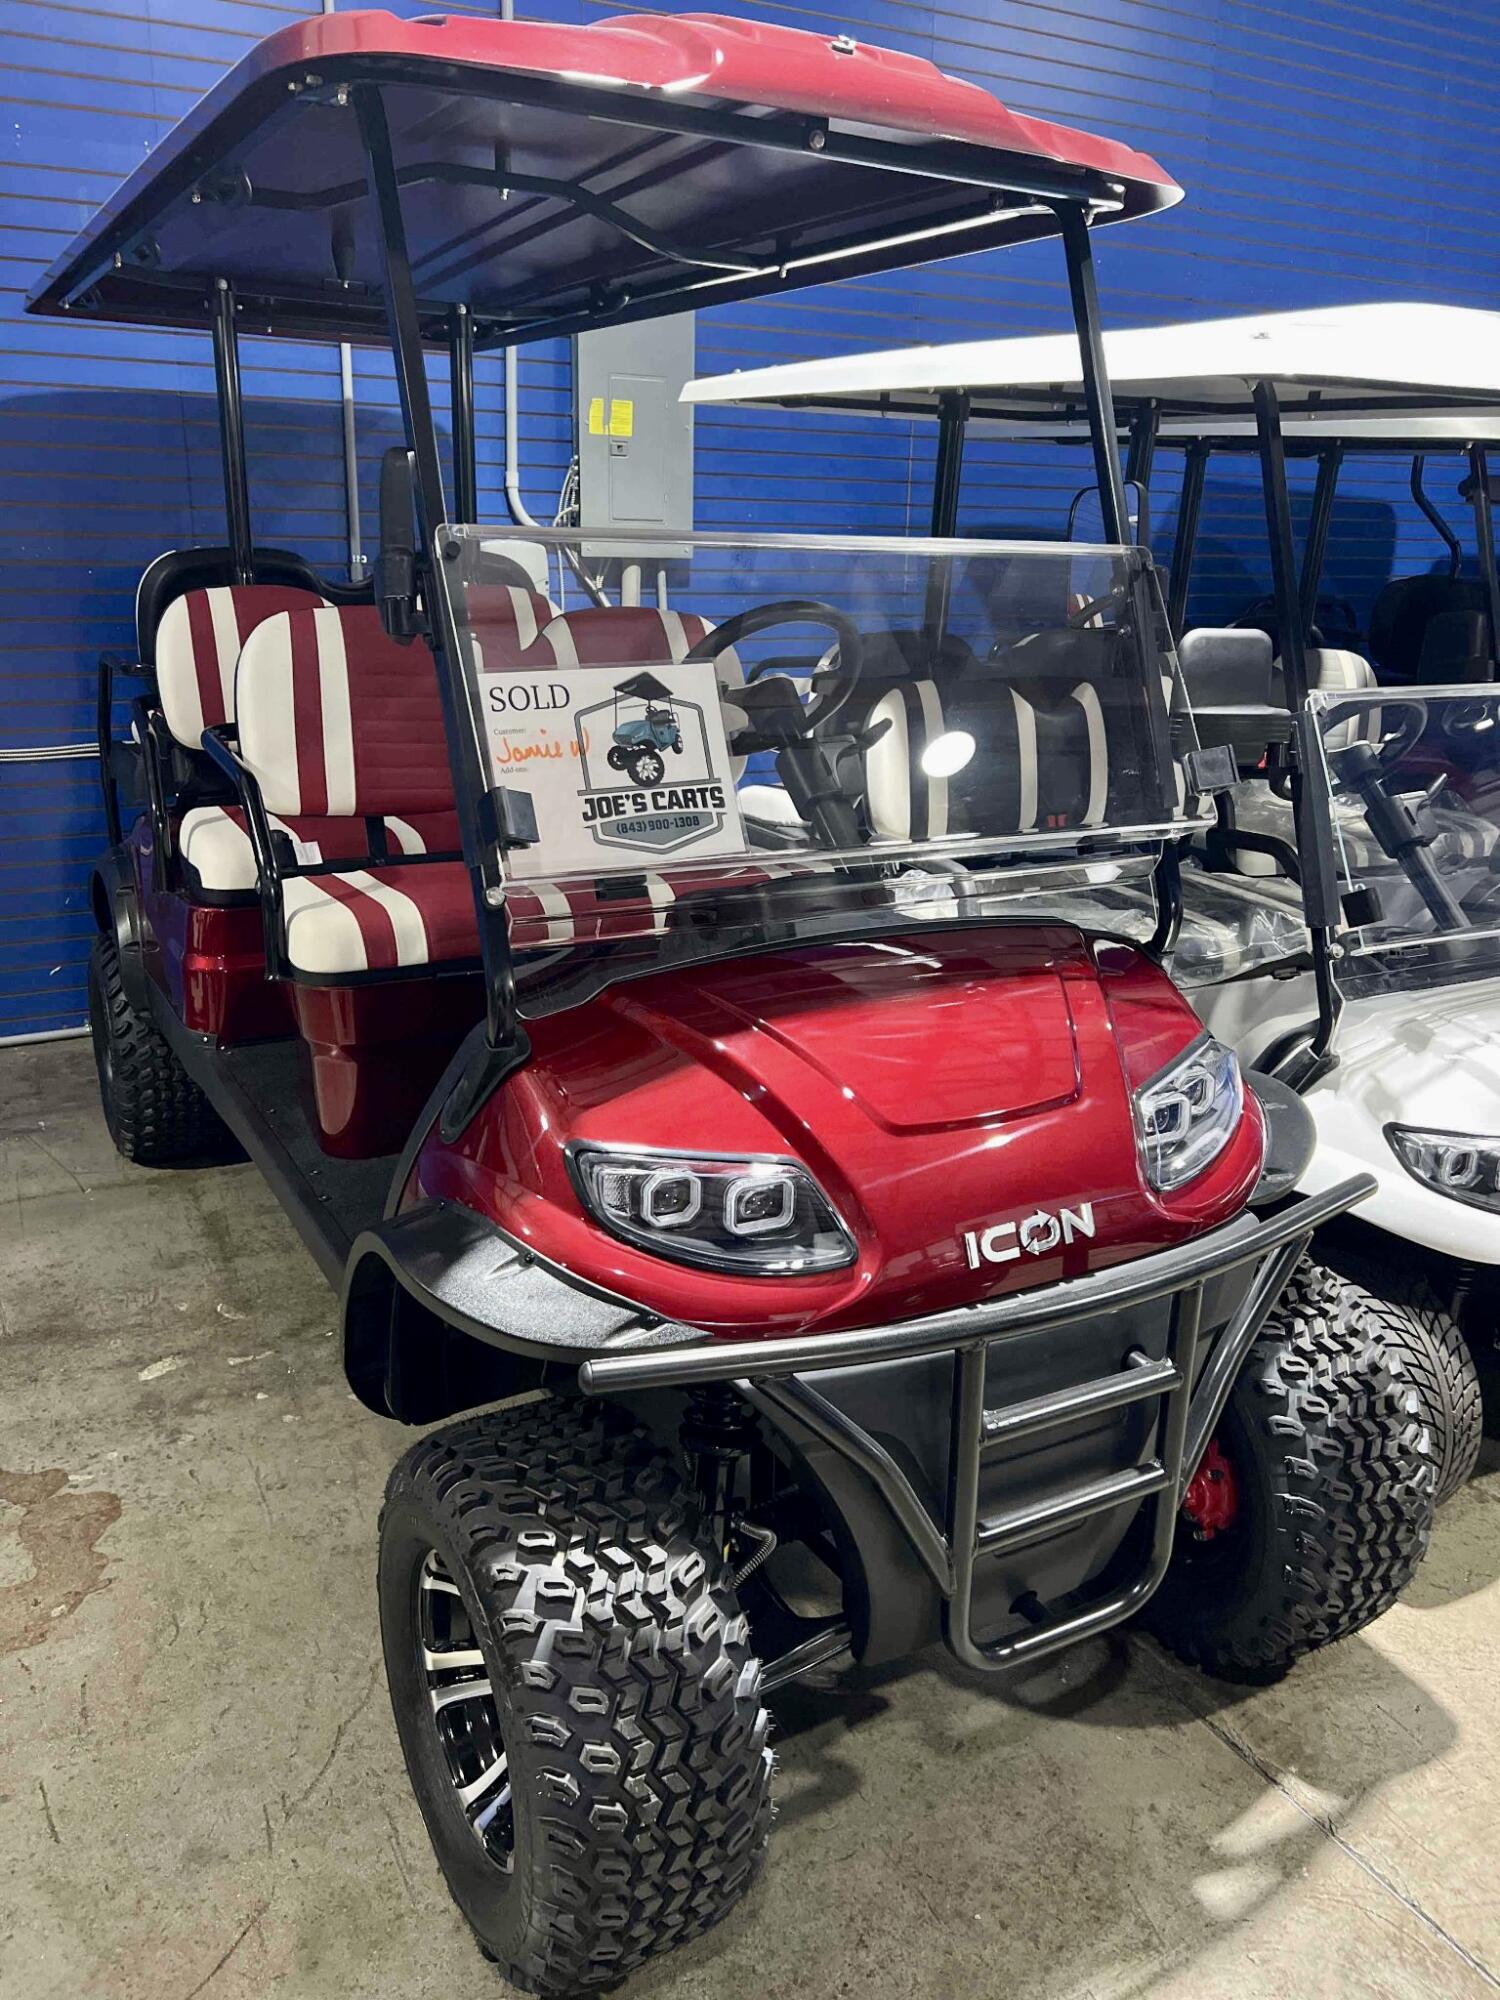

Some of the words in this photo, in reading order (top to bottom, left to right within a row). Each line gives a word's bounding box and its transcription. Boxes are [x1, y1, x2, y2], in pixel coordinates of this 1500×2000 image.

[489, 684, 570, 712] SOLD
[582, 792, 648, 822] JOE'S
[650, 786, 726, 811] CARTS
[616, 820, 647, 834] (843)
[964, 1202, 1096, 1270] ICON
